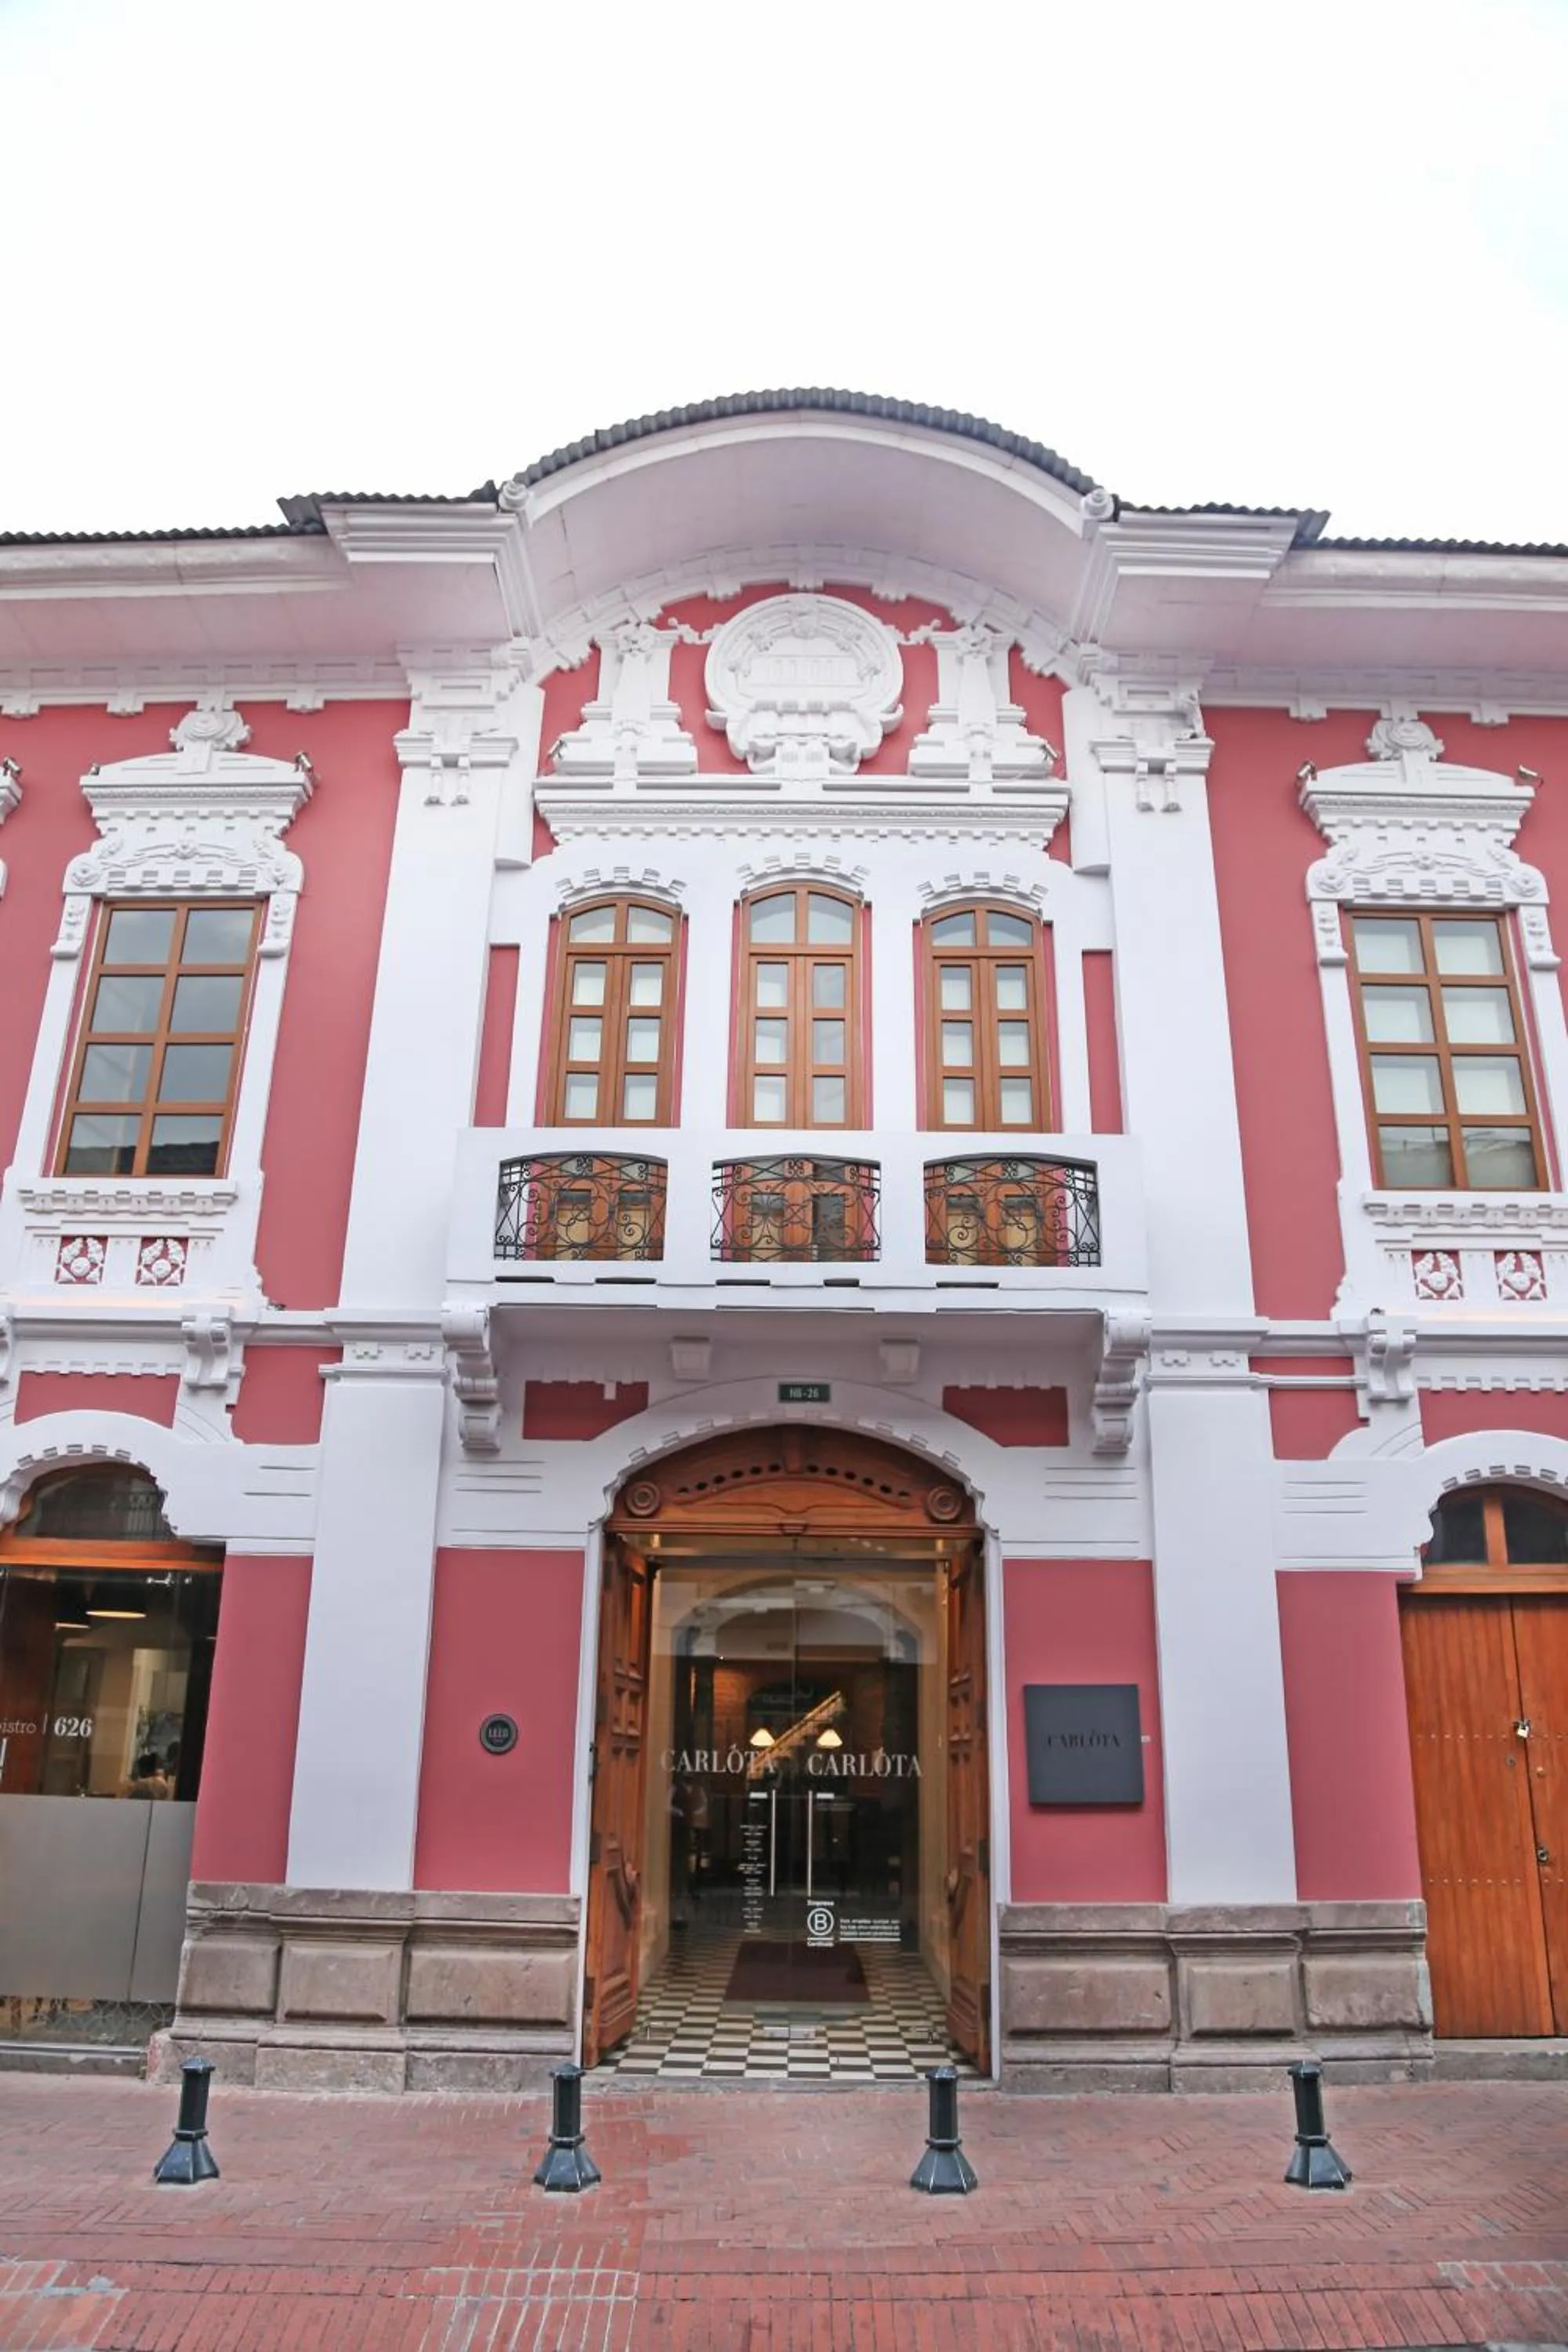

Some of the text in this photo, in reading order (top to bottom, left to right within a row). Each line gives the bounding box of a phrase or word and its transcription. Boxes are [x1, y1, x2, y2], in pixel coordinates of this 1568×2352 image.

[0, 1716, 93, 1737] istro 626
[815, 1914, 827, 1930] B
